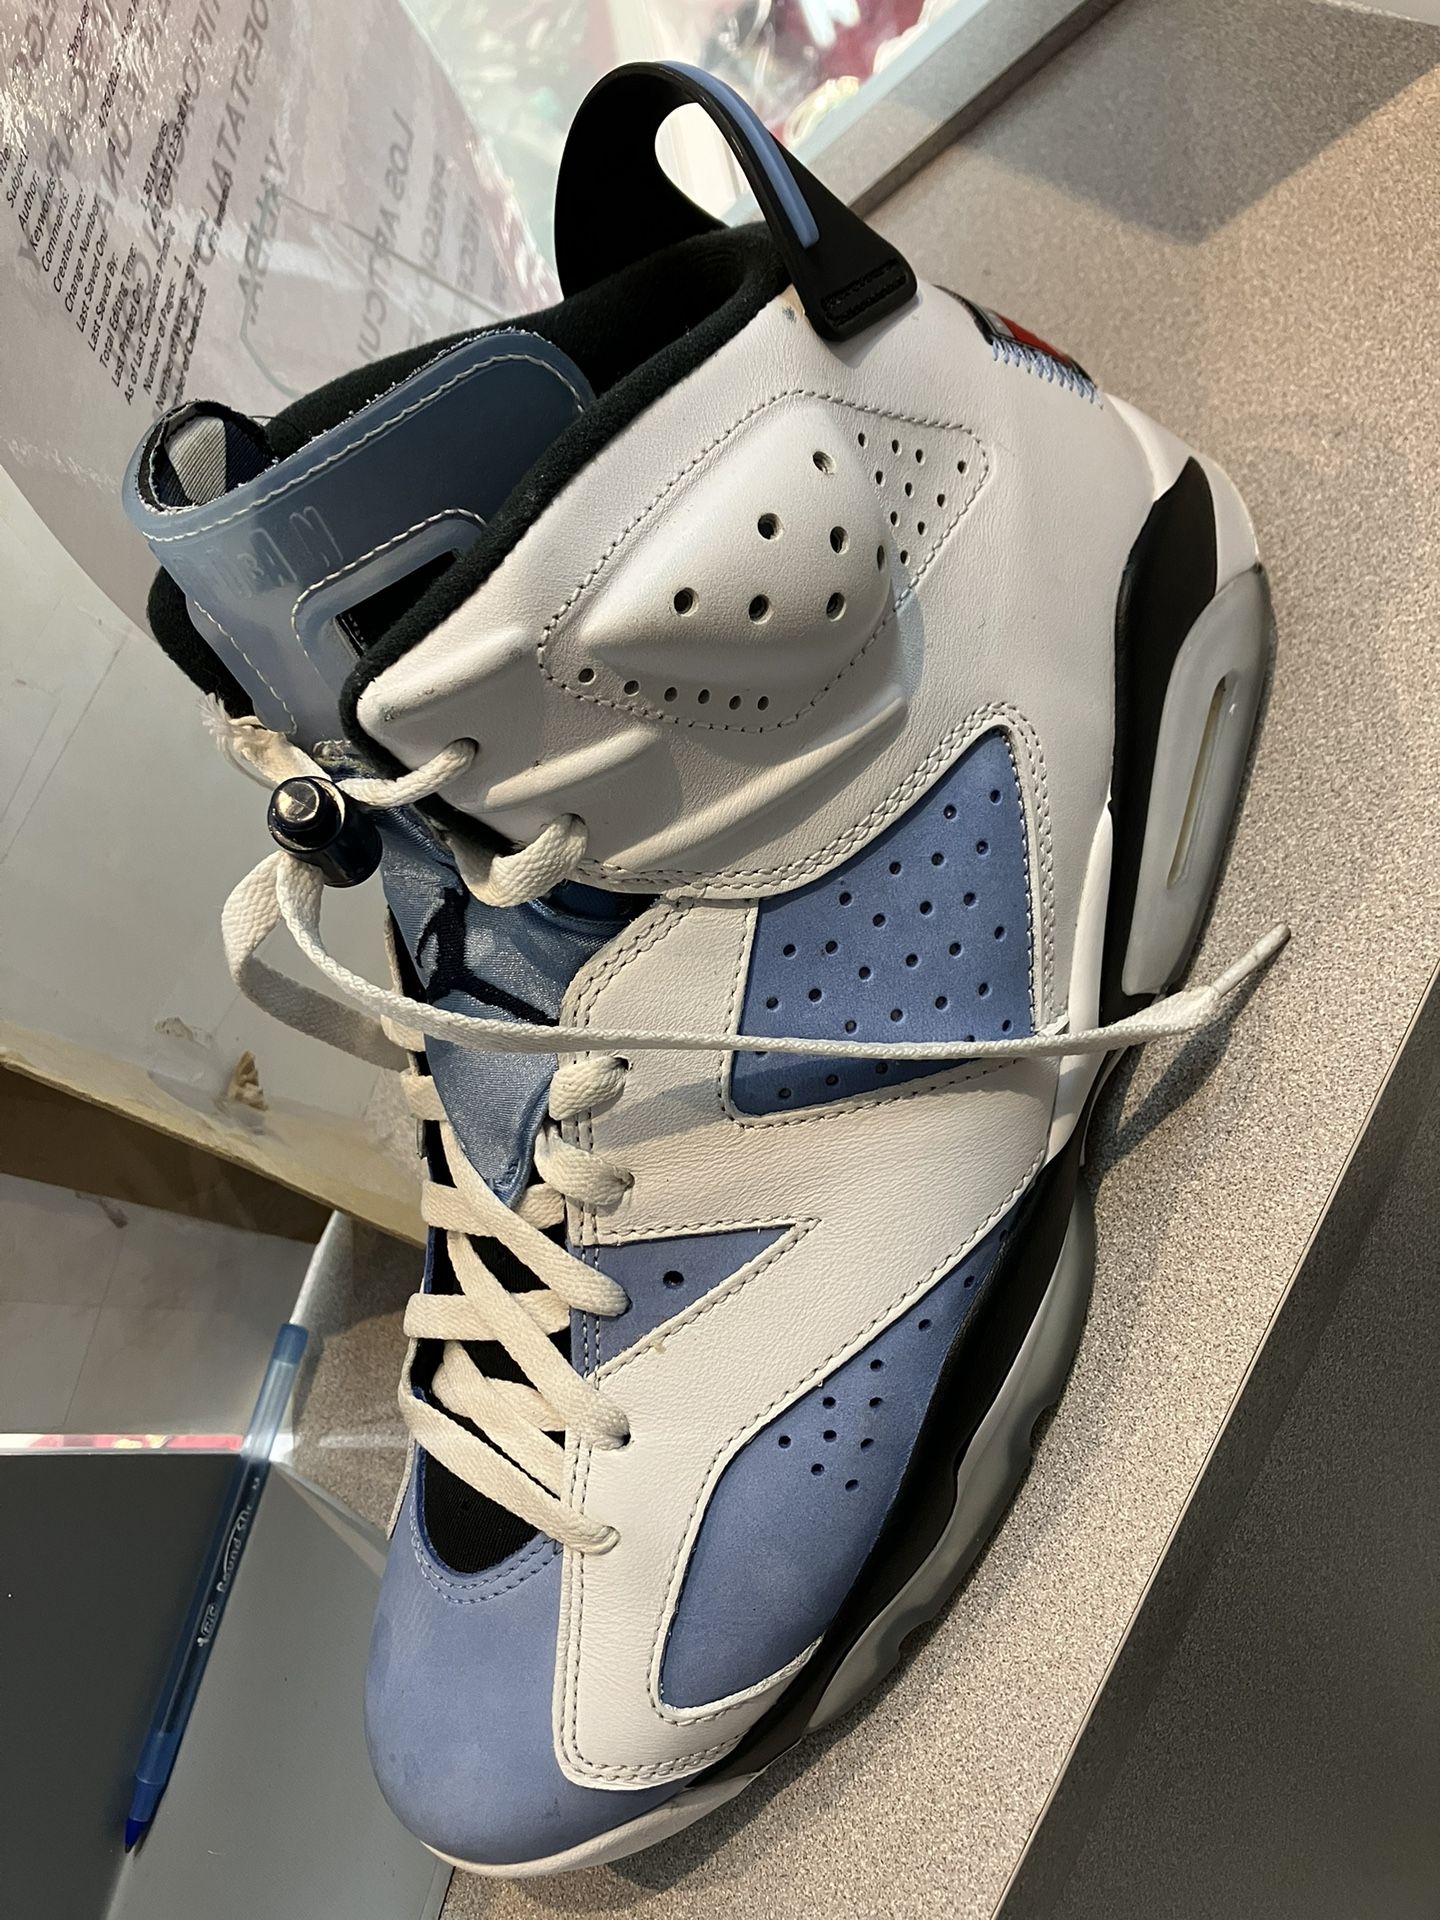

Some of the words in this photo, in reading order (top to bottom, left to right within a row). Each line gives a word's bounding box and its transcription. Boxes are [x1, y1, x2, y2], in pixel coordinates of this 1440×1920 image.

[18, 170, 40, 231] Author:
[30, 174, 57, 252] Keywords:
[42, 188, 70, 272] Comments:
[53, 242, 75, 293] Creation
[70, 188, 86, 231] Date:
[65, 257, 84, 313] Change
[76, 299, 90, 333] Last
[84, 257, 101, 302] Saved
[88, 319, 101, 351] Last
[96, 275, 114, 322] Saved
[99, 329, 115, 369] Total
[109, 281, 129, 332] Editing
